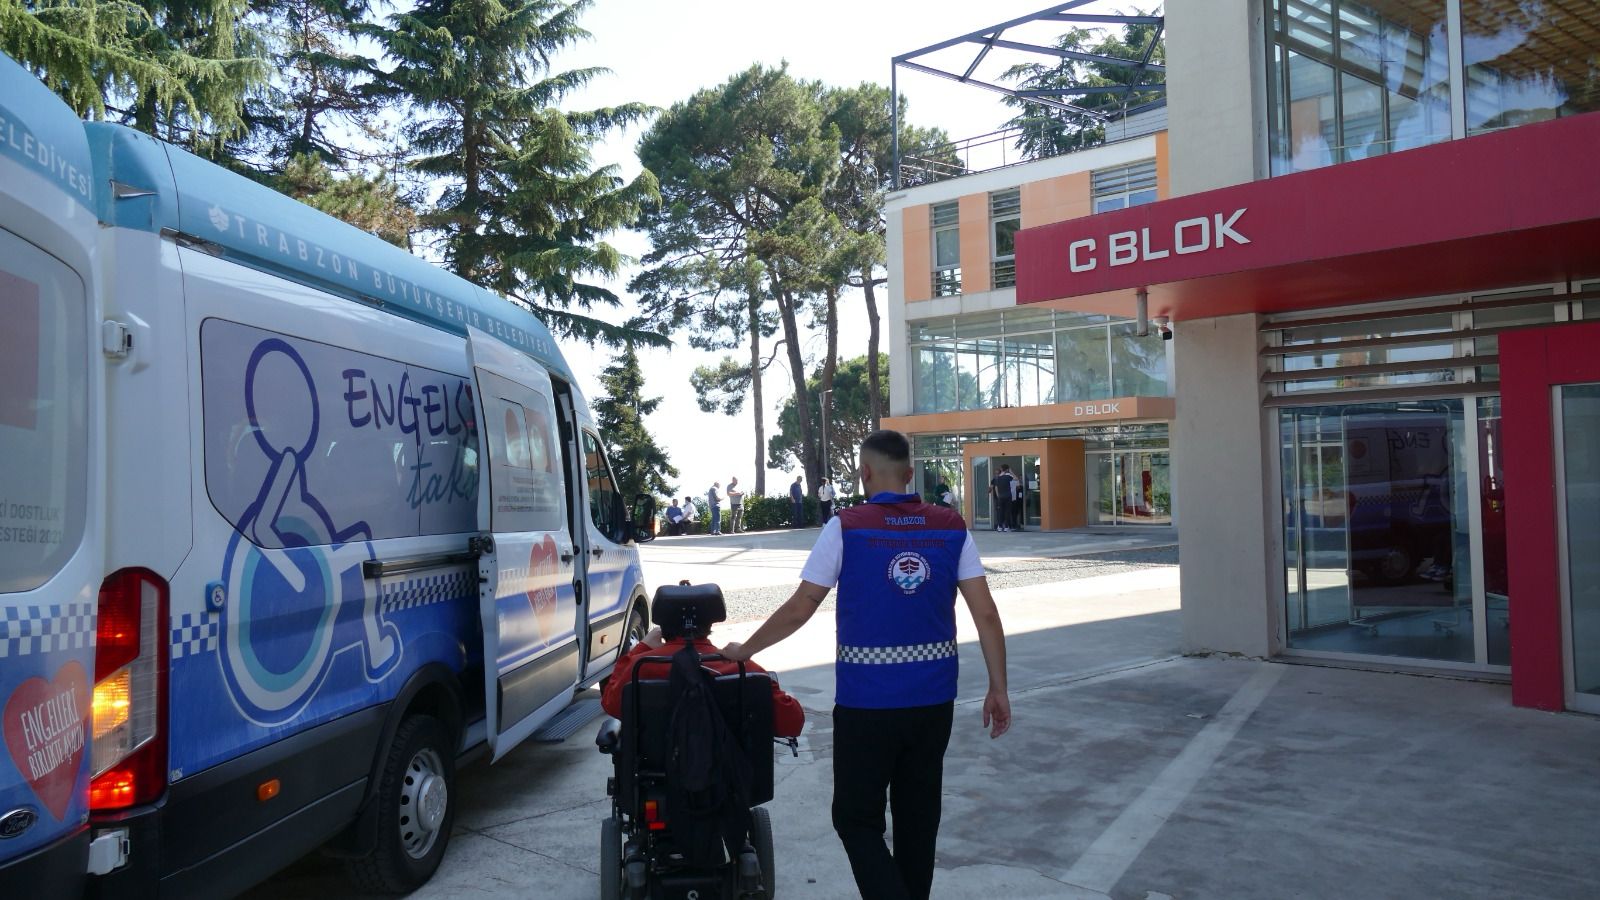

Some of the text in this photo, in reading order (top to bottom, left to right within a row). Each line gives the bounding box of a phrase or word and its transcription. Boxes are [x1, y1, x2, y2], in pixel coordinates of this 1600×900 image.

[235, 215, 359, 281] TRABZON
[373, 269, 480, 328] BÜYÜKŞEHİR
[1069, 208, 1251, 273] C BLOK
[342, 368, 478, 447] ENGELS
[1074, 402, 1120, 416] D BLOK
[884, 516, 926, 526] TRABZON
[20, 682, 80, 750] ENGELLERİ
[28, 742, 65, 781] BİRLİKTE
